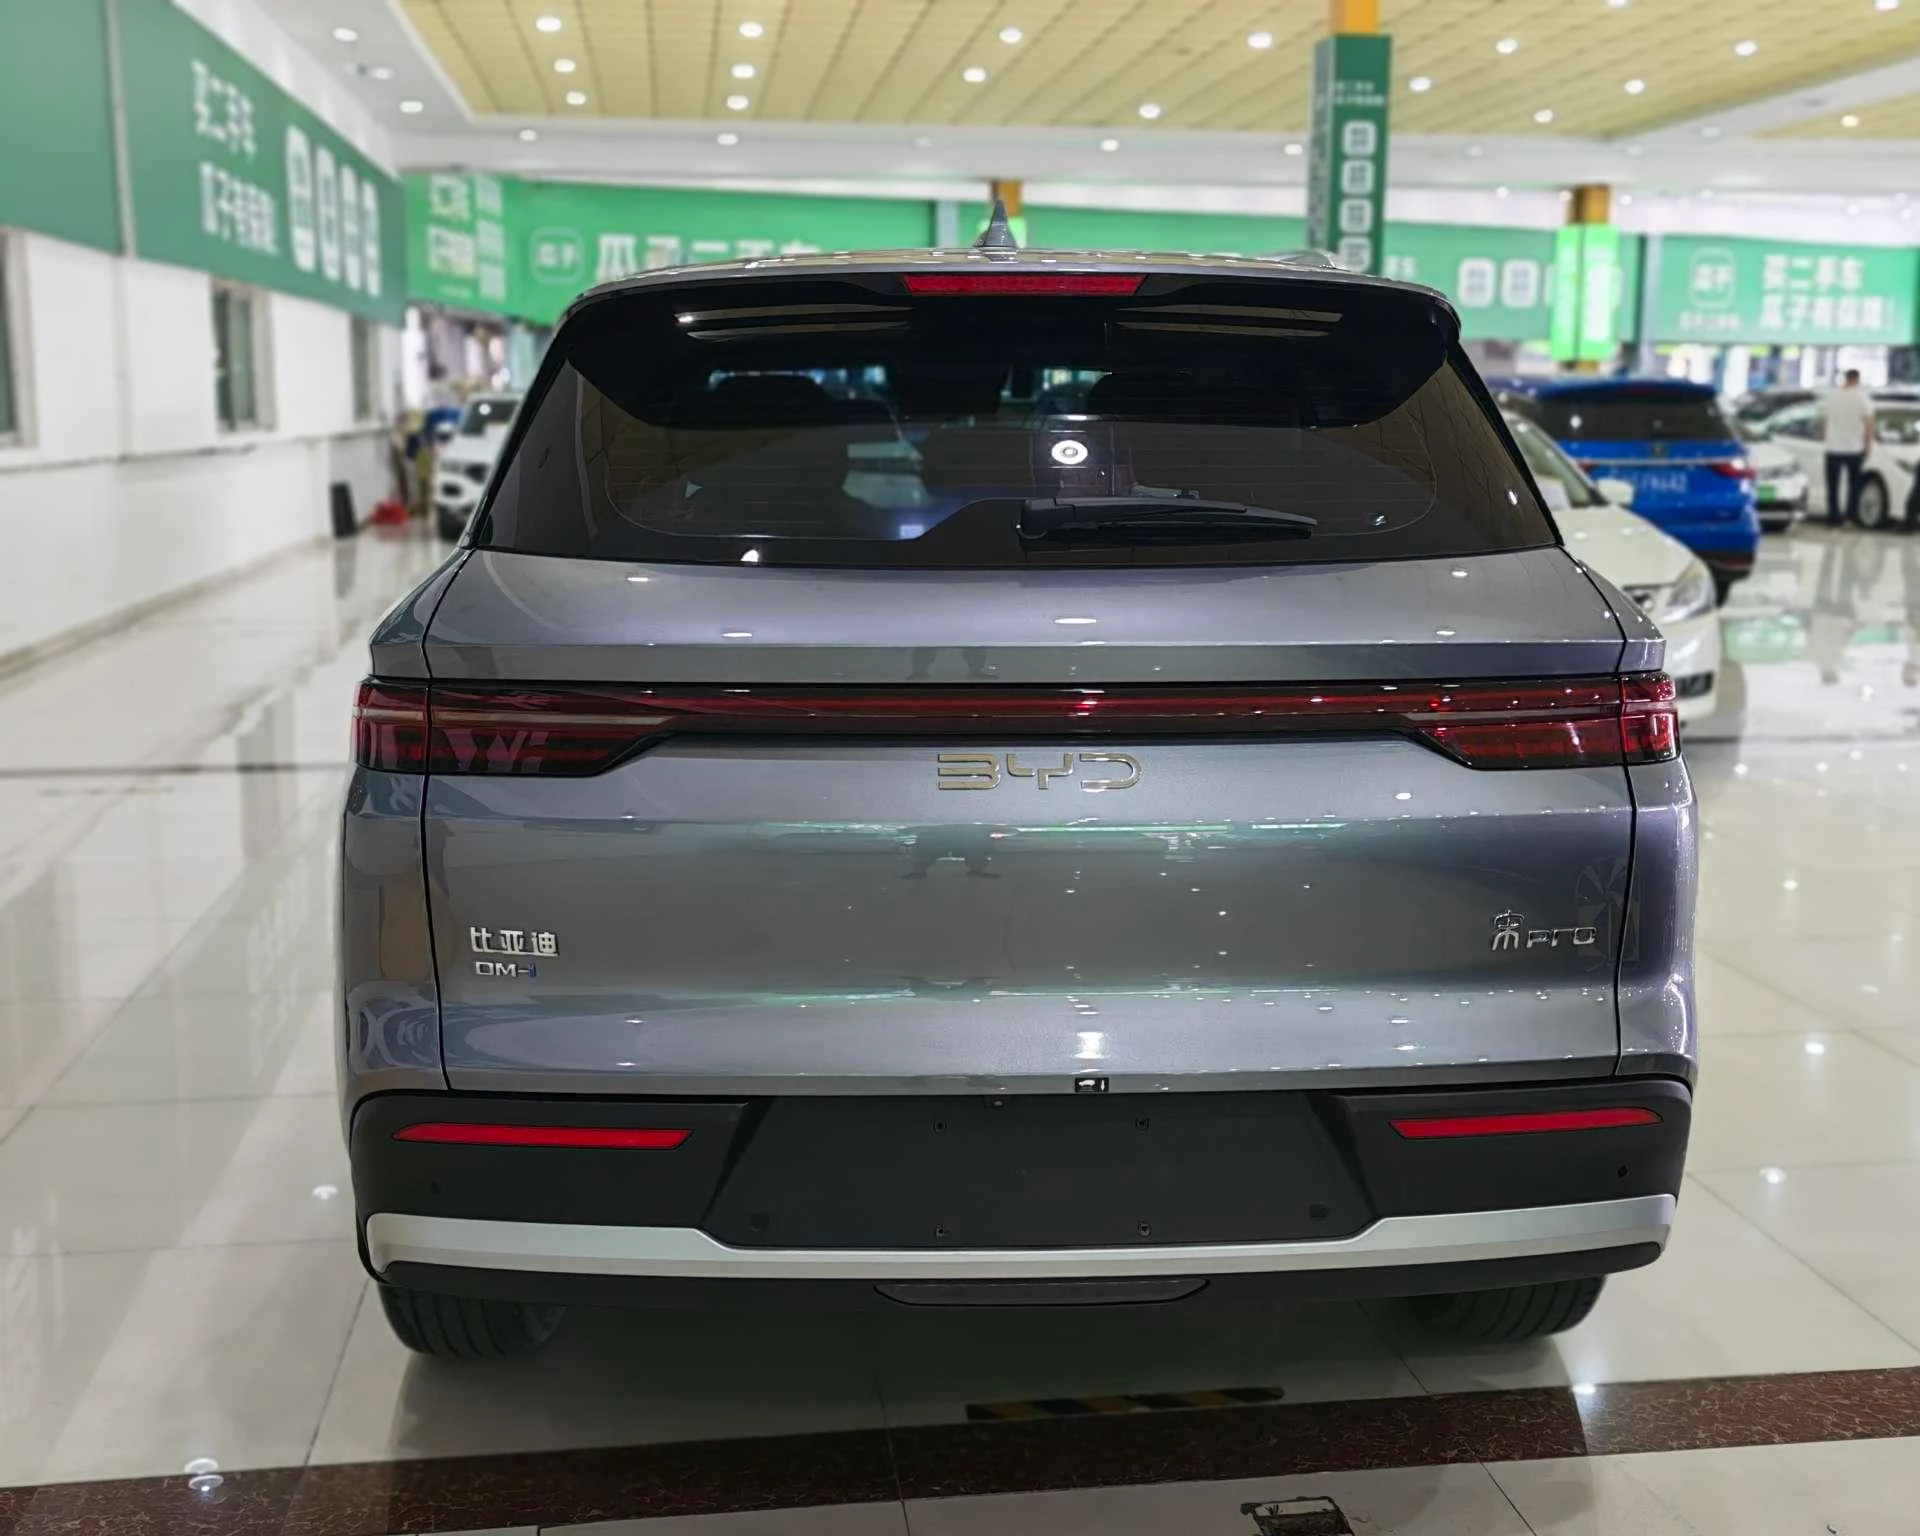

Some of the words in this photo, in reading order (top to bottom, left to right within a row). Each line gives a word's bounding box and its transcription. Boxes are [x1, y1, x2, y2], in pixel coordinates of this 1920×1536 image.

[937, 752, 1143, 792] BYD
[470, 926, 559, 957] 比亚迪
